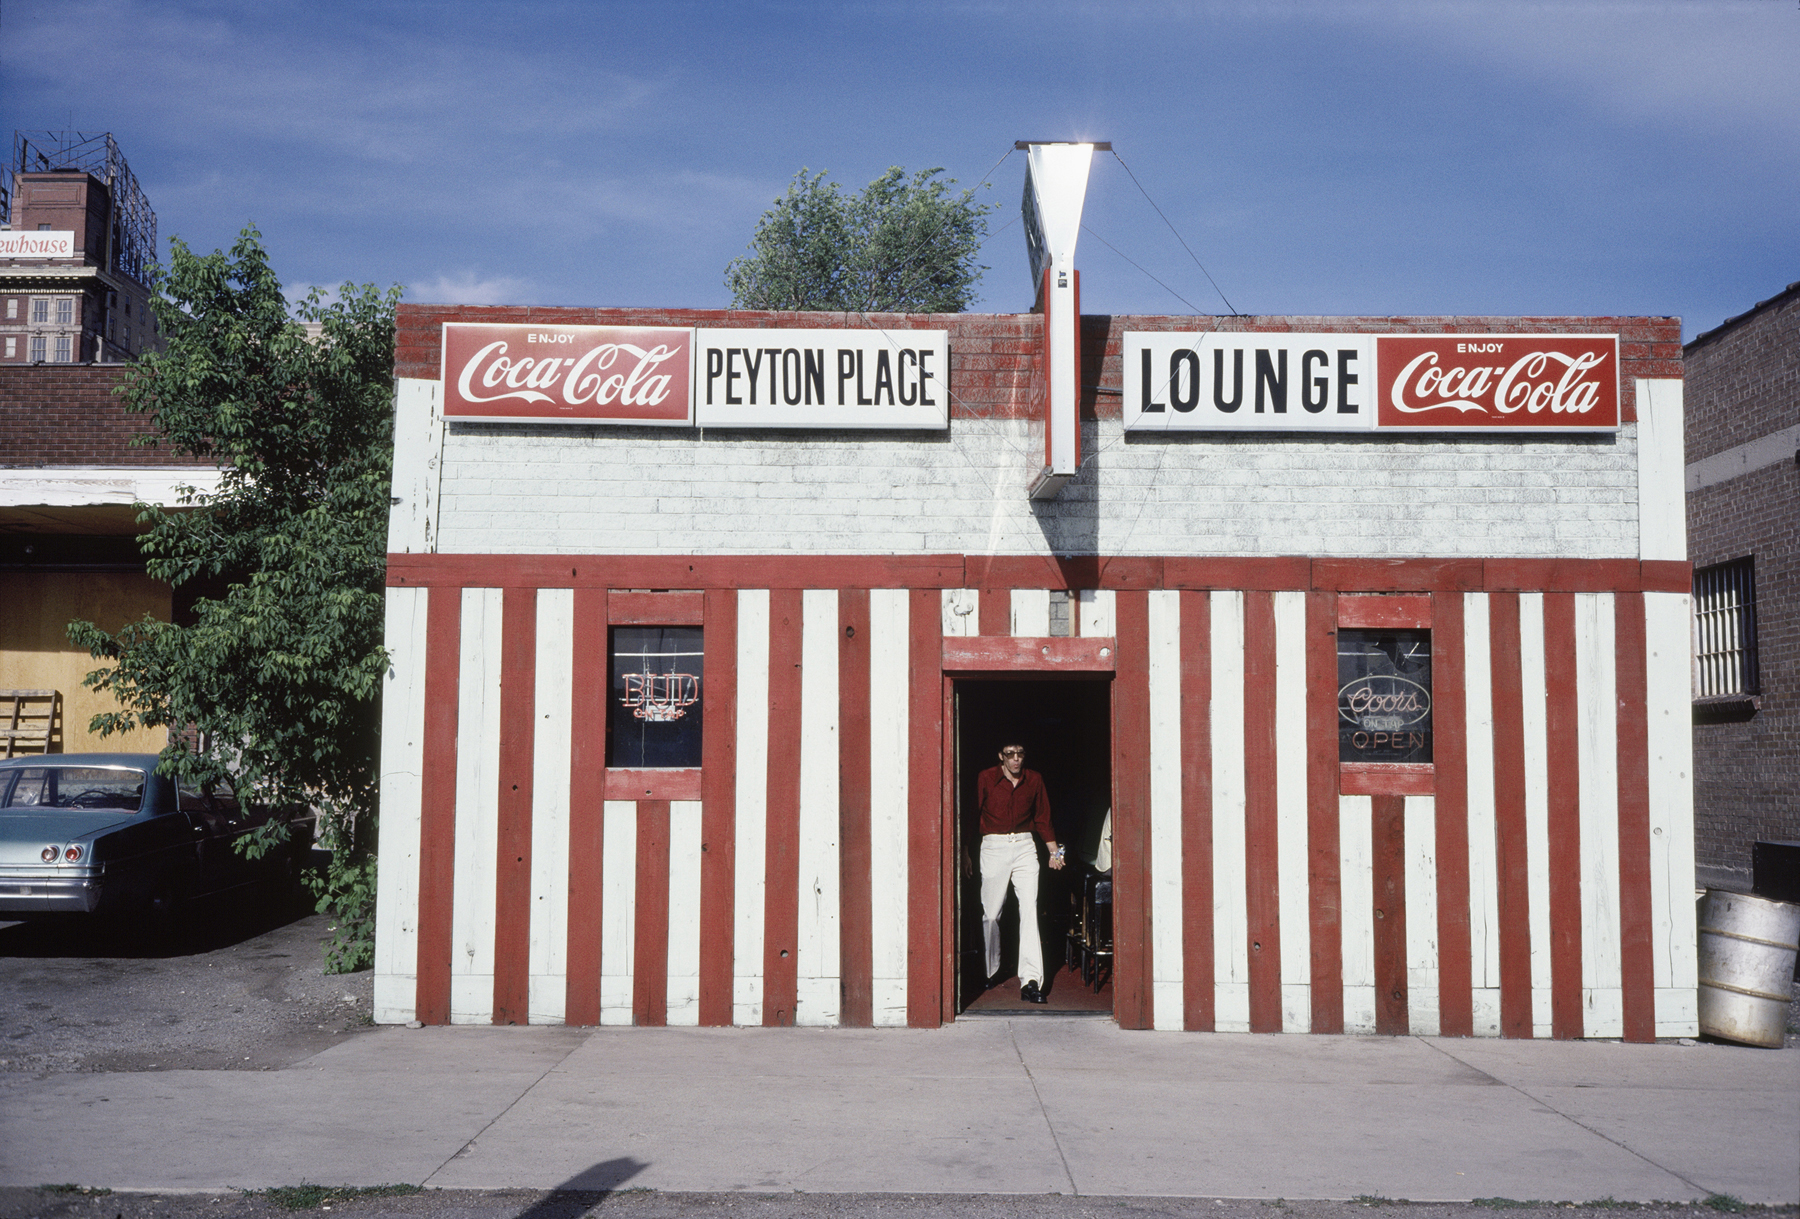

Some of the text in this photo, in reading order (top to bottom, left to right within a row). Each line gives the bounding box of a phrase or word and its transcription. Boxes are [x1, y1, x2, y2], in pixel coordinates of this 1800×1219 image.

[527, 333, 576, 344] ENJOY
[1457, 343, 1504, 353] ENJOY
[458, 341, 682, 406] Coca-Cola
[706, 347, 936, 406] PEYTON PLACE
[1141, 348, 1359, 414] LOUNGE
[1391, 351, 1608, 414] Coca-Cola
[622, 673, 698, 707] BUD
[1347, 687, 1422, 712] Coors
[633, 708, 685, 719] ON TAP
[1363, 718, 1378, 728] ON
[1352, 731, 1424, 749] OPEN
